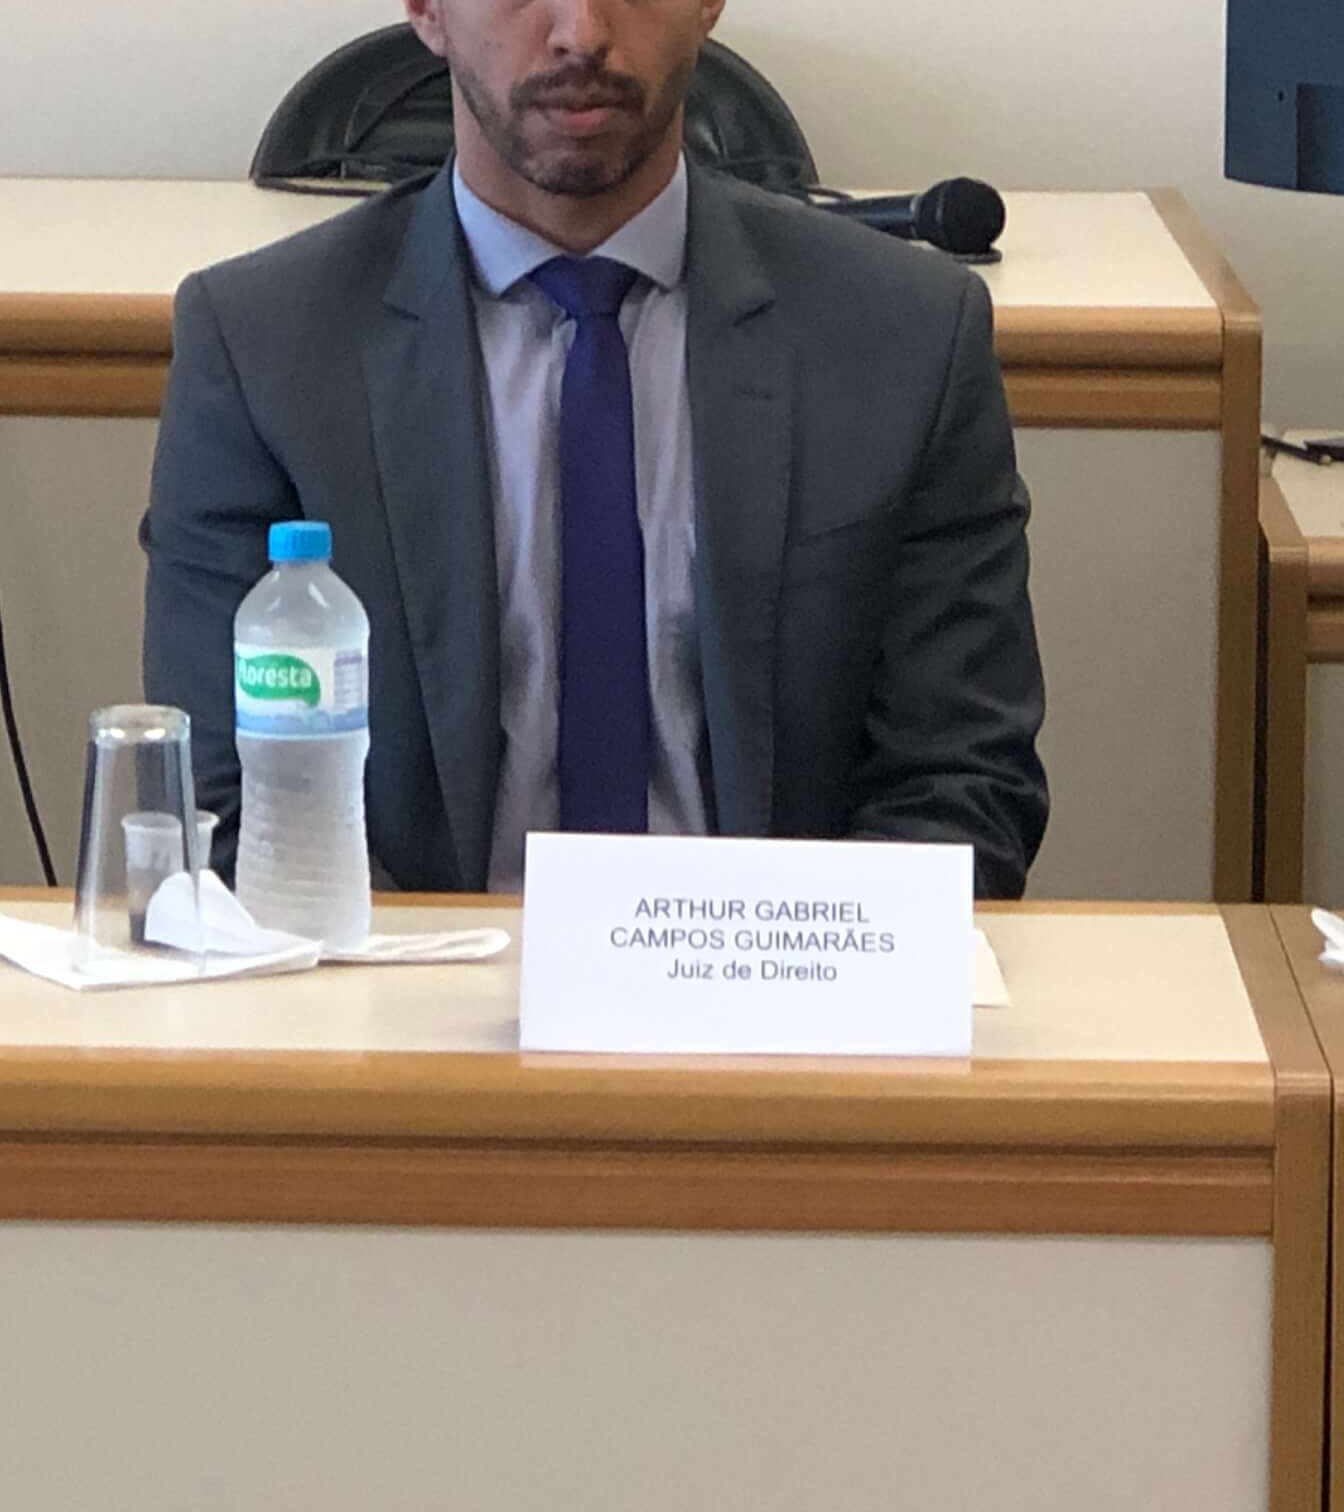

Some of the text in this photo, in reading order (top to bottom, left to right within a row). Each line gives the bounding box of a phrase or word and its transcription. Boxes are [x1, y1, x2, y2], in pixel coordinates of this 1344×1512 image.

[635, 897, 870, 924] ARTHUR GABRIEL
[610, 926, 895, 953] CAMPOS GUIMARÃES
[667, 959, 838, 982] Juiz de Direito
